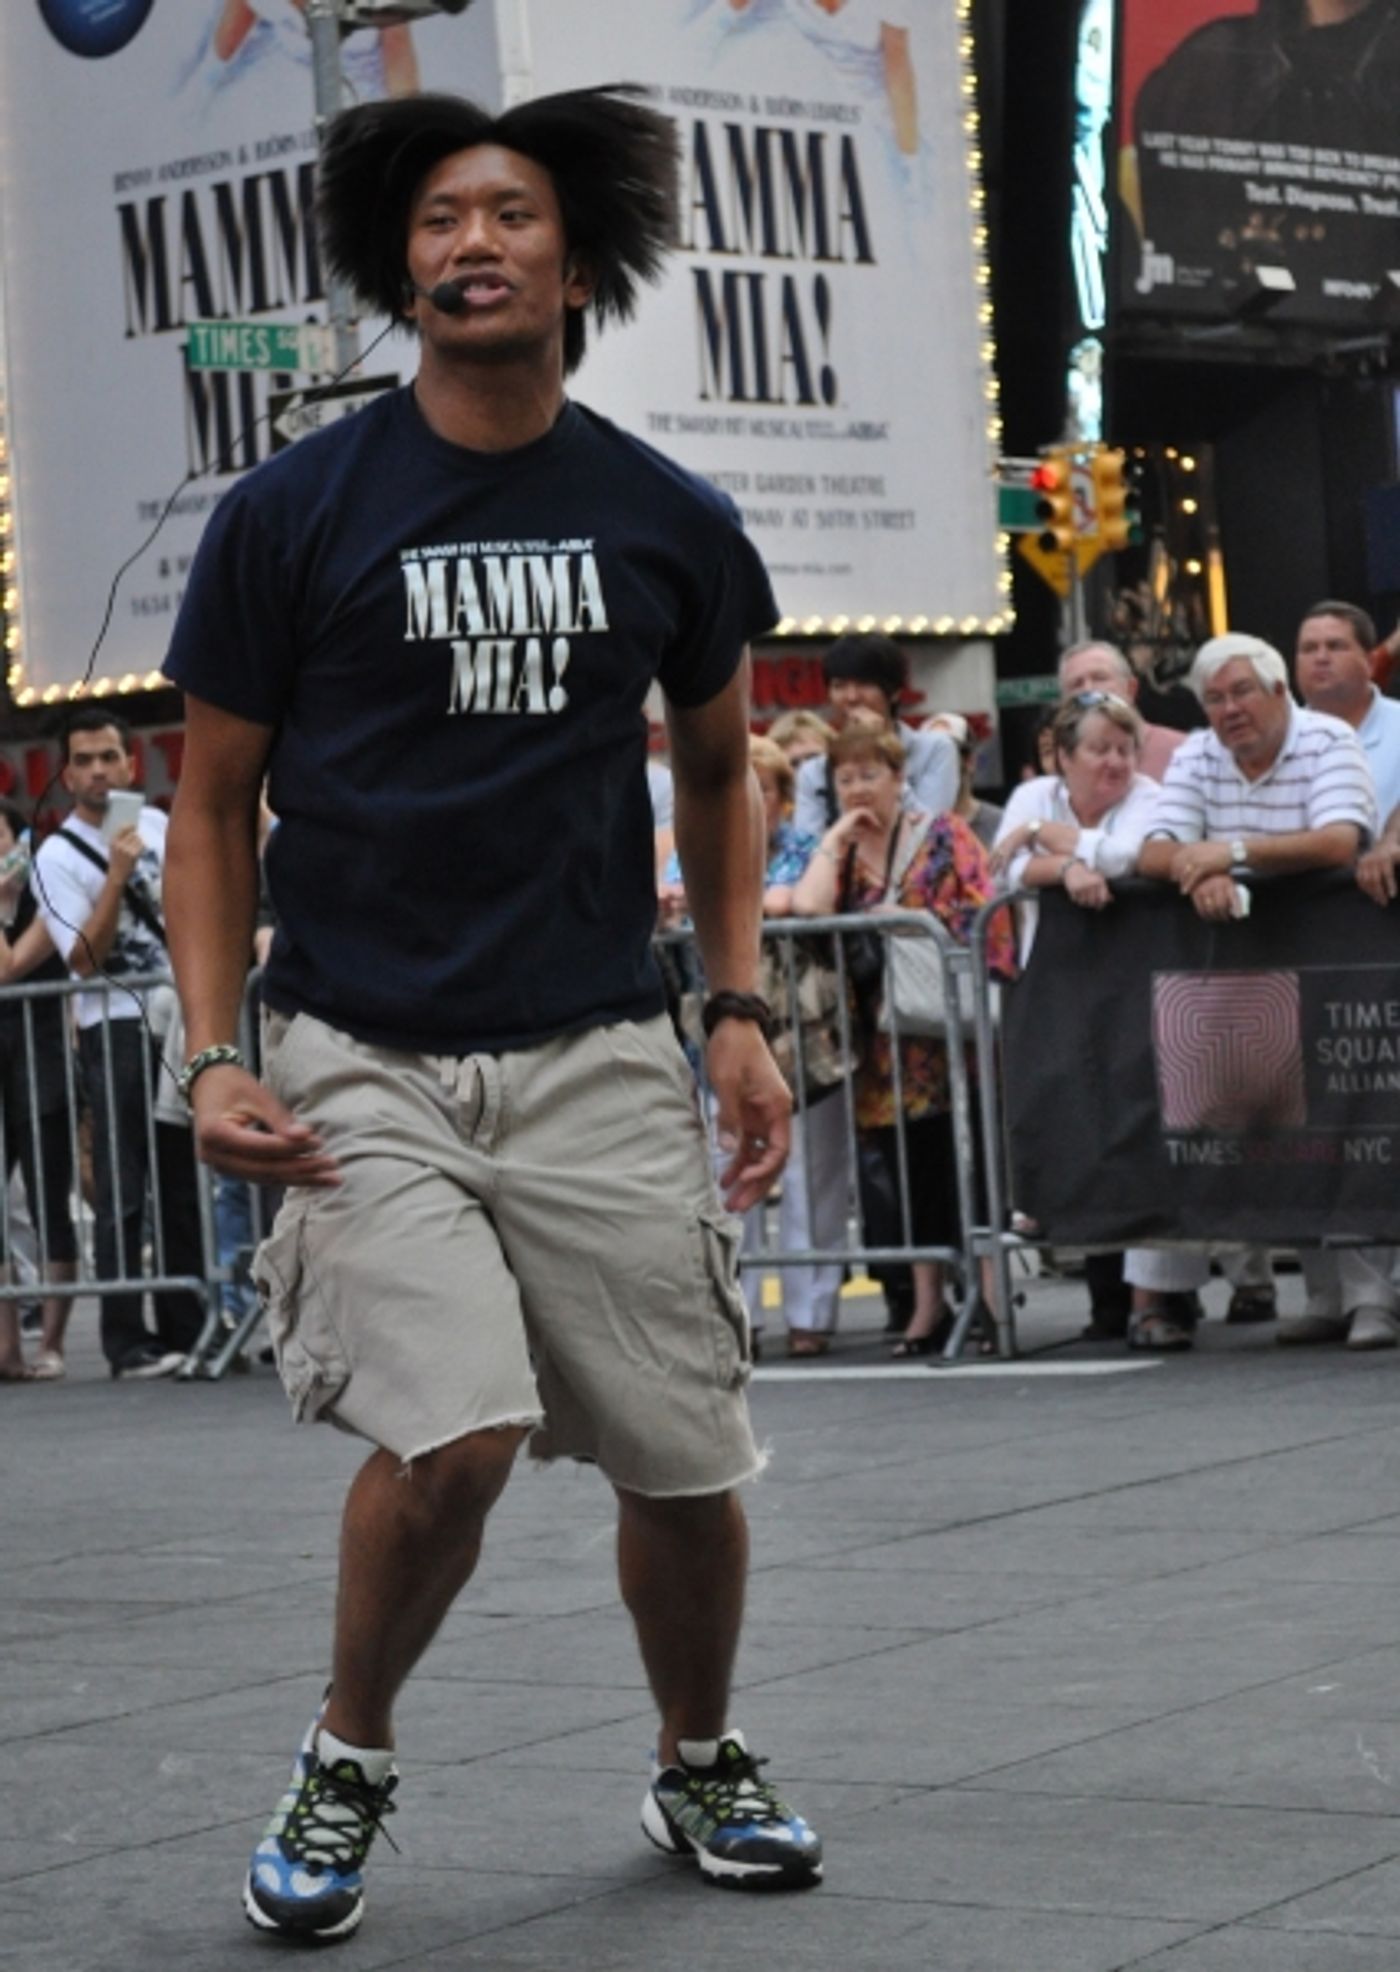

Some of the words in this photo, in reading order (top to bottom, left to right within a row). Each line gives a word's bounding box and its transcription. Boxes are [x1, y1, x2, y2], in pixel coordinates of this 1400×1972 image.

[672, 118, 877, 266] AMMA
[116, 160, 326, 340] MAMM
[193, 326, 272, 366] TIMES
[690, 266, 838, 407] MIA!
[755, 473, 815, 494] GARDEN
[821, 474, 887, 497] THEATRE
[862, 510, 916, 531] STREET
[401, 552, 610, 641] MAMMA
[447, 636, 571, 715] MIA!
[1315, 1037, 1400, 1069] SQUA
